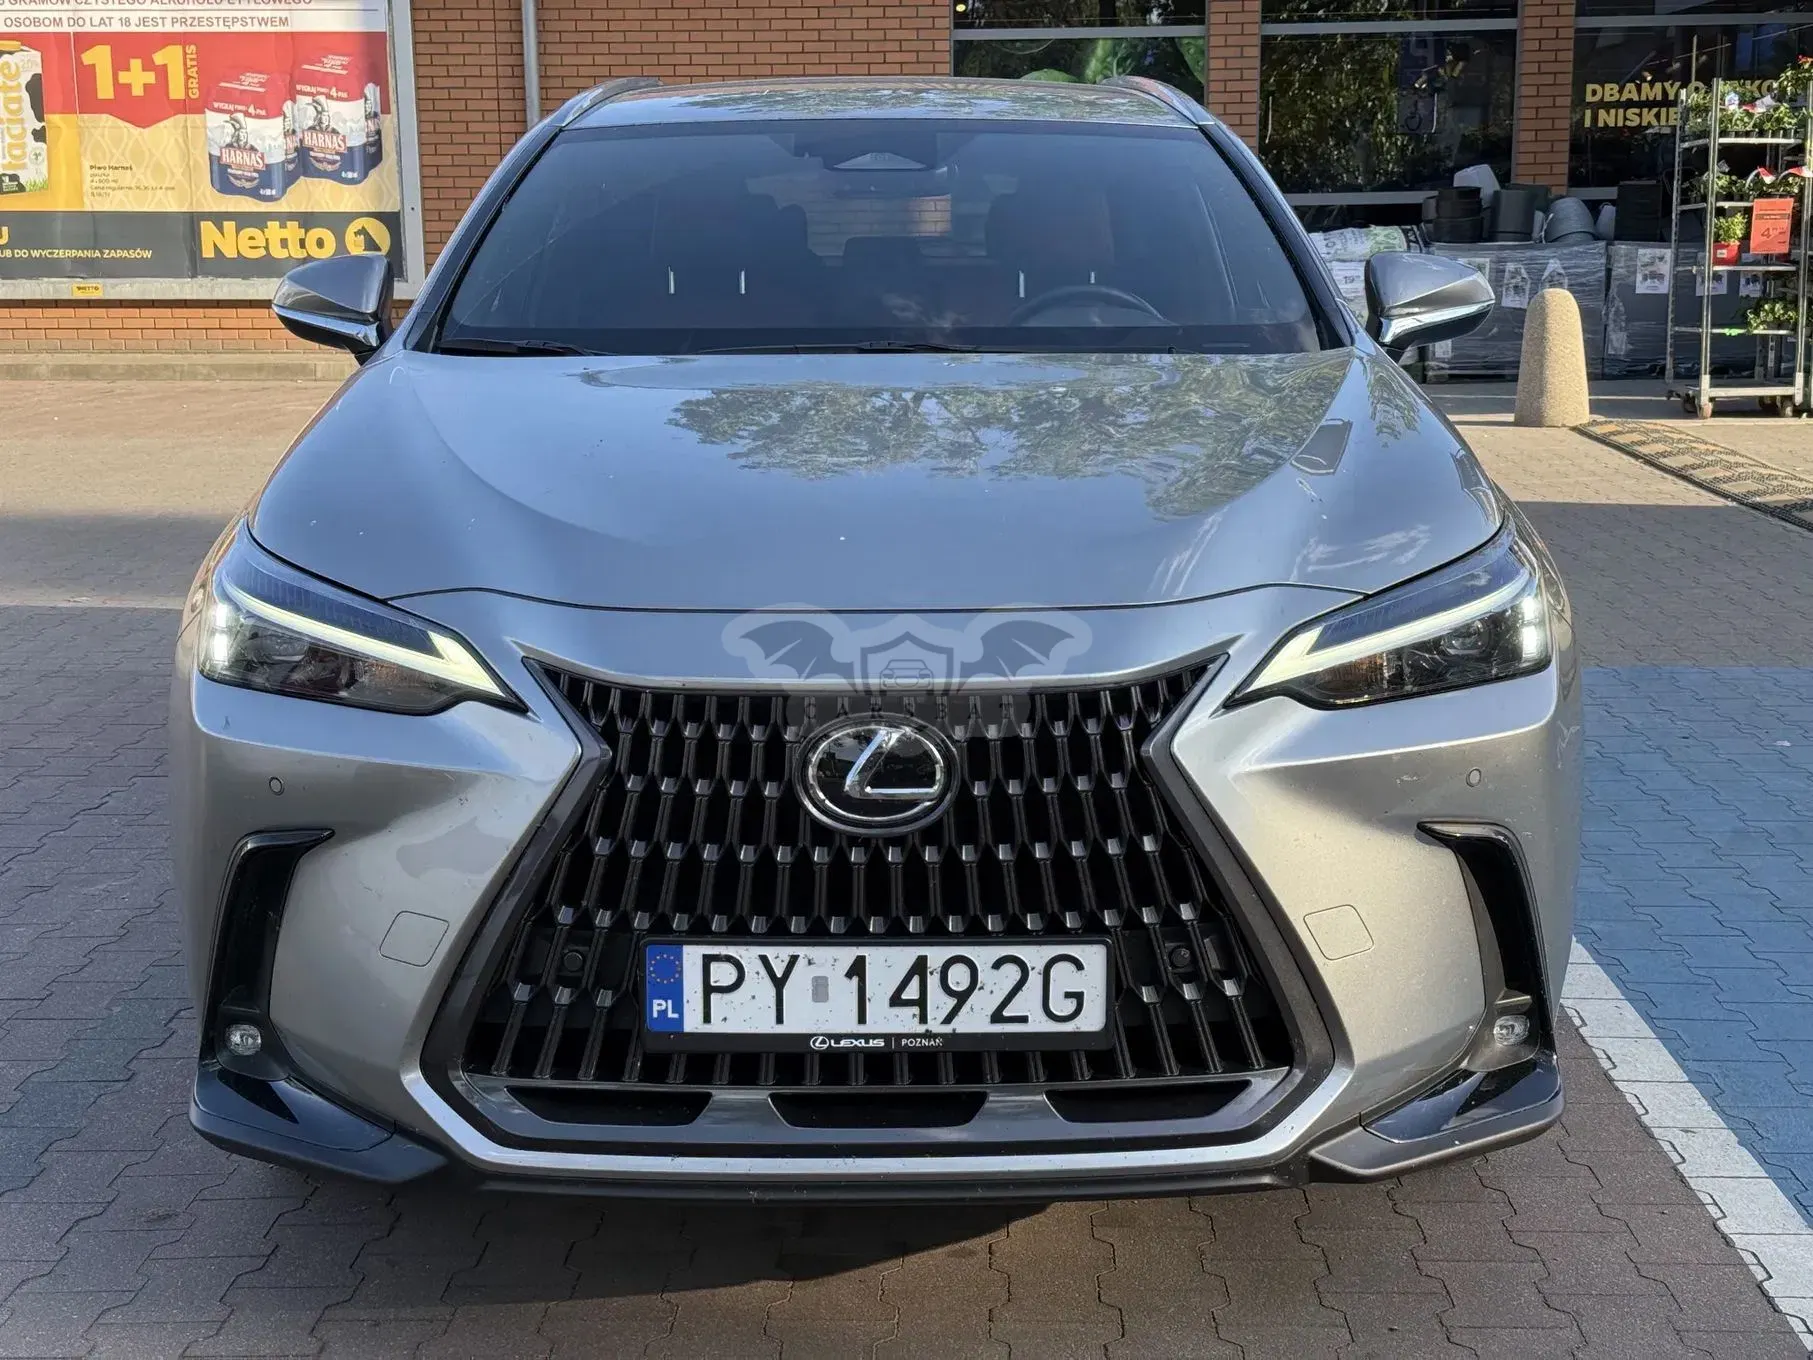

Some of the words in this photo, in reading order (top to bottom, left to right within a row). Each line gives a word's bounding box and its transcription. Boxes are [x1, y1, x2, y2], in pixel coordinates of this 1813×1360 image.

[4, 17, 63, 28] OSOBOM
[67, 17, 86, 28] DO
[90, 17, 114, 28] LAT
[118, 17, 132, 28] 18
[134, 16, 168, 28] JEST
[171, 16, 290, 29] PRZESTĘPSTWEM
[185, 44, 200, 99] GRATIS
[1585, 82, 1682, 103] DBAMY
[1584, 109, 1591, 128] I
[200, 220, 337, 260] Netto
[14, 249, 29, 258] DO
[31, 249, 101, 258] WYCZERPANIA
[103, 247, 152, 259] ZAPASÓW
[702, 953, 800, 1025] PY
[844, 953, 1086, 1025] 1492G
[652, 1000, 679, 1018] PL
[831, 1038, 885, 1047] LEXUS
